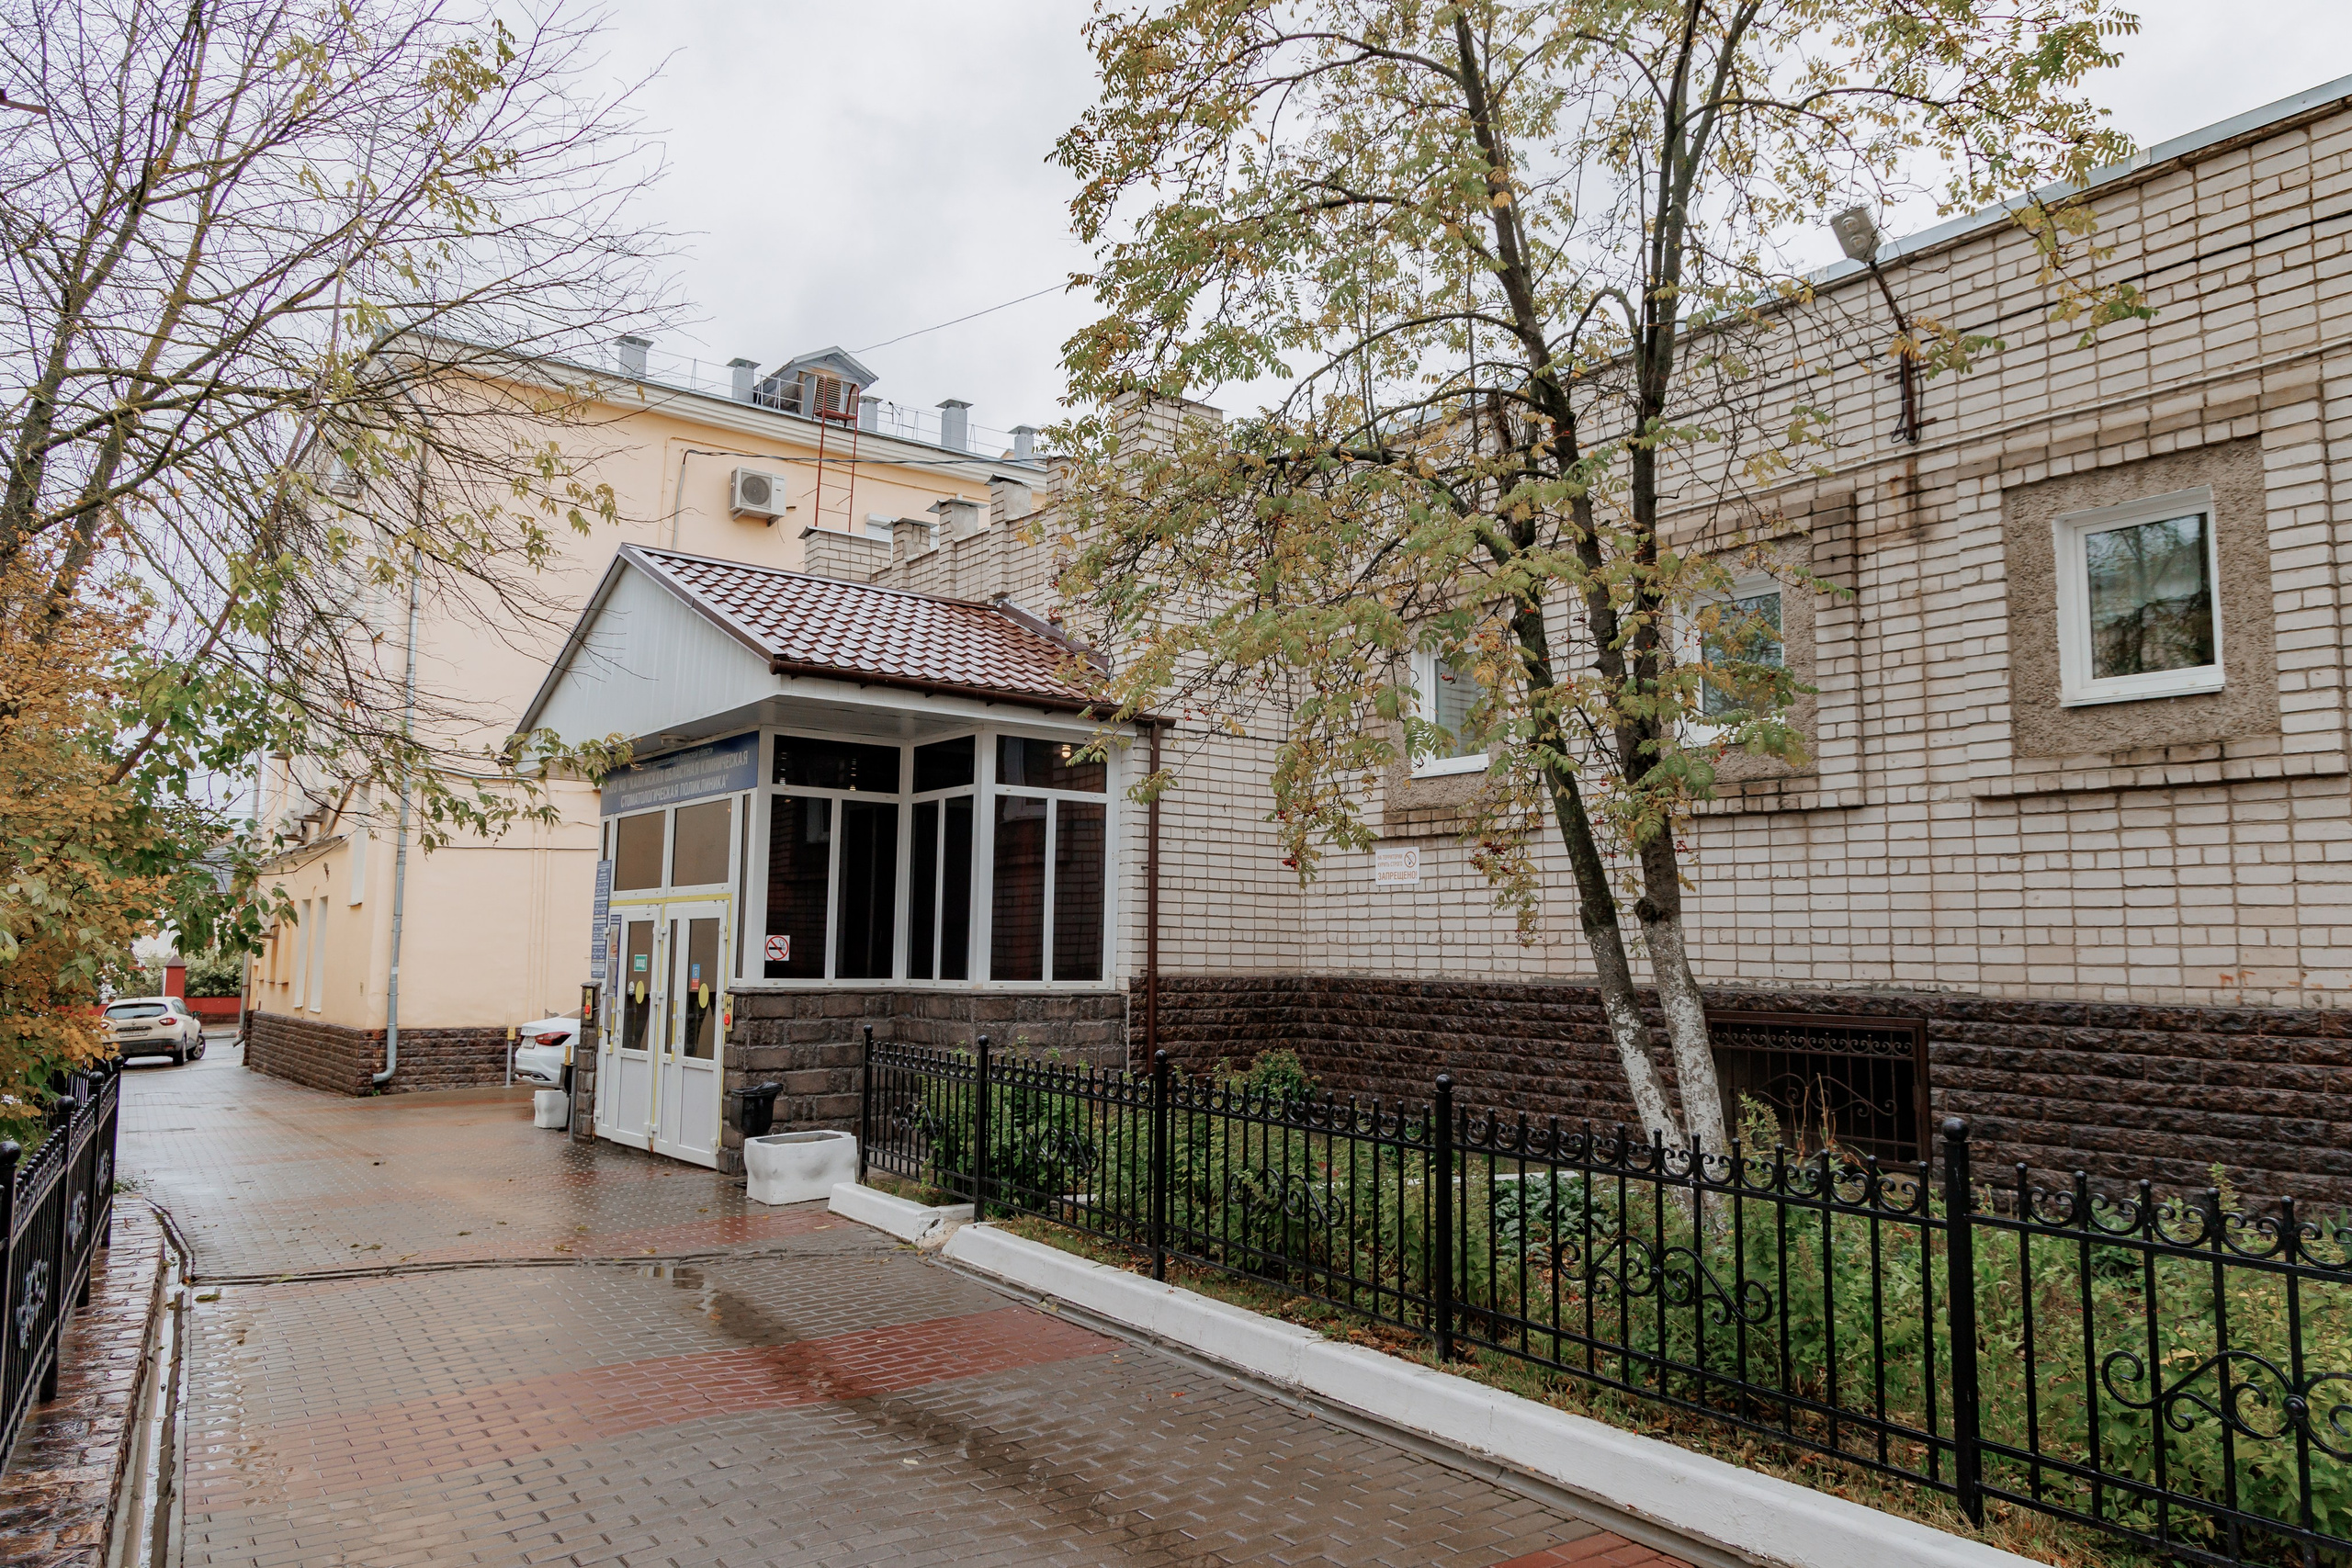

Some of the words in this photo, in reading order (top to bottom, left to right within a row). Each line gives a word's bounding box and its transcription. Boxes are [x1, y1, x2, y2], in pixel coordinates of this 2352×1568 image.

[664, 761, 699, 782] ОБЛАСТНАЯ
[700, 750, 749, 774] КЛИНИЧЕСКАЯ
[620, 784, 679, 807] СТОМАТОЛОГИЧЕСКАЯ
[680, 773, 729, 796] ПОЛИКЛИНИКА"
[1378, 871, 1417, 880] ЗАПРЕЩЕНО!
